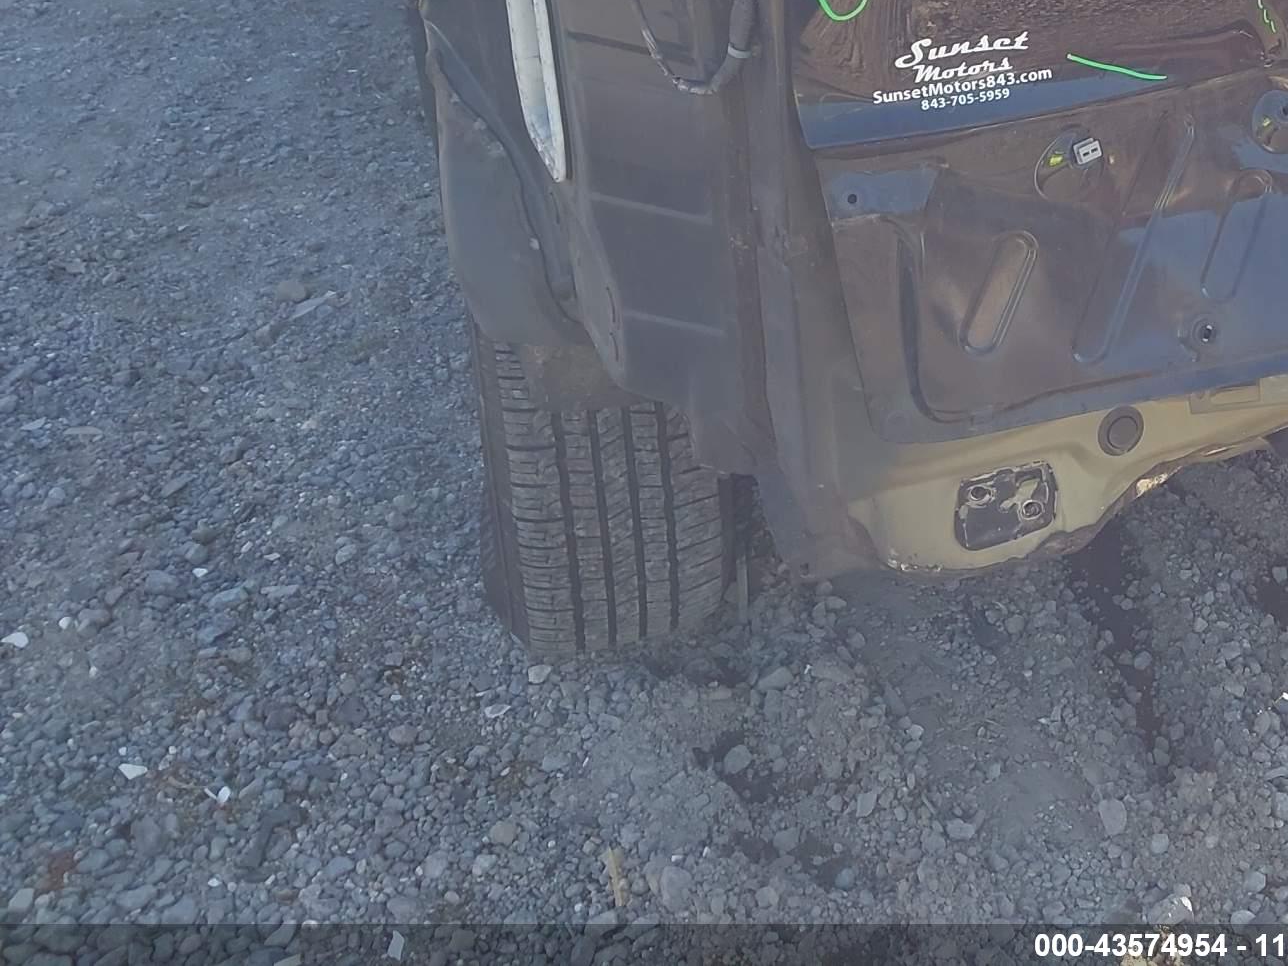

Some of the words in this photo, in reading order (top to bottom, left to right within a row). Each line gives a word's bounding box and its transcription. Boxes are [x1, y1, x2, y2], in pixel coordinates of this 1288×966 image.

[894, 31, 1029, 68] Sunset
[912, 57, 1013, 83] Motors
[872, 68, 1052, 105] SunsetMotors843.com
[920, 87, 1010, 111] 843-705-5959
